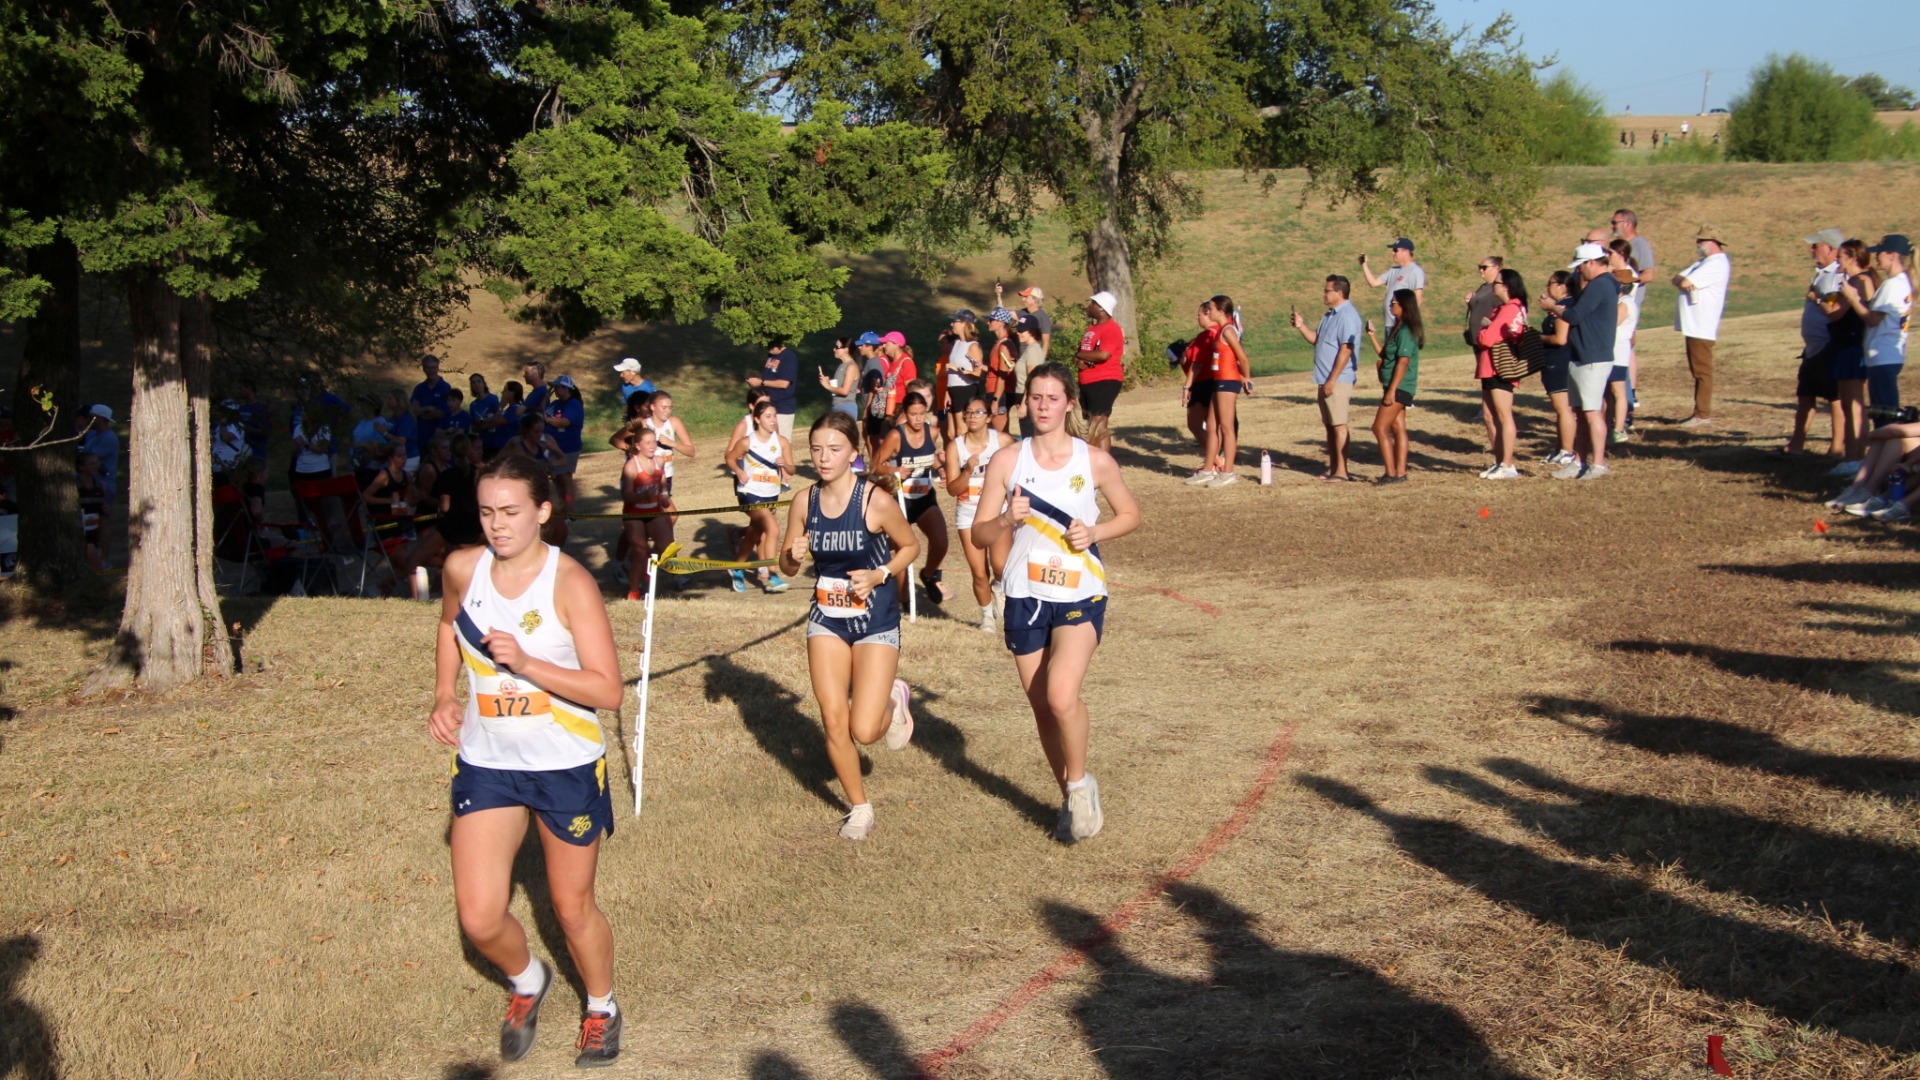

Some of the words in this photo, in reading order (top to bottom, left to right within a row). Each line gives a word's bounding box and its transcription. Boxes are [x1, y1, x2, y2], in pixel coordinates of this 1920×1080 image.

[807, 530, 820, 551] HE
[822, 531, 864, 551] GROVE
[1040, 567, 1066, 586] 153
[827, 592, 852, 608] 559
[494, 696, 532, 717] 172
